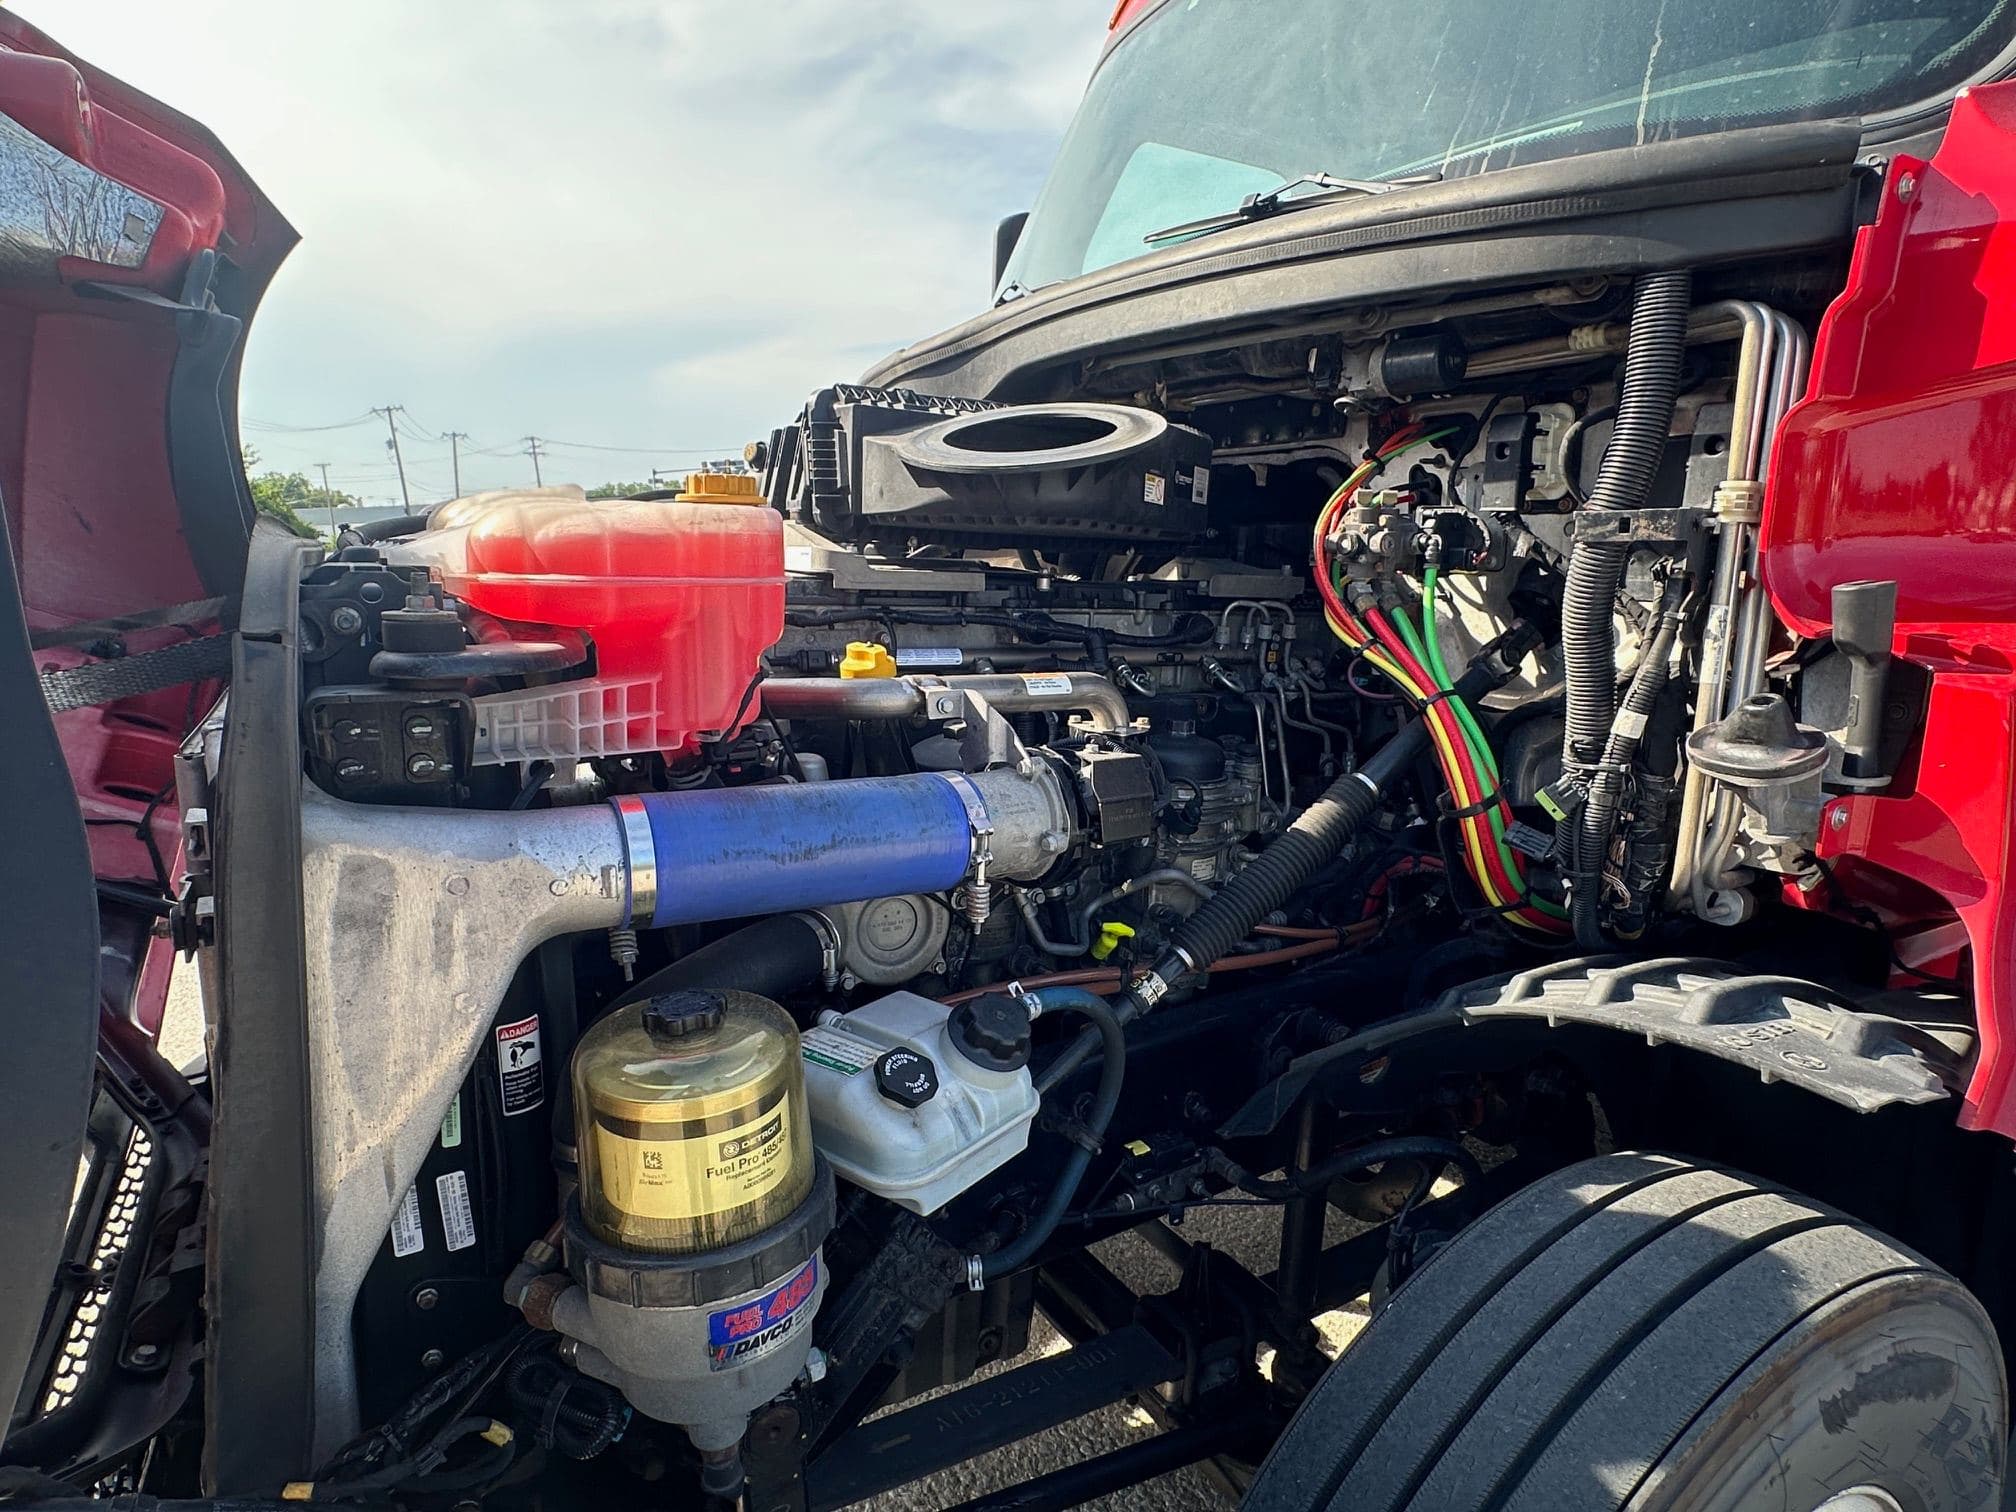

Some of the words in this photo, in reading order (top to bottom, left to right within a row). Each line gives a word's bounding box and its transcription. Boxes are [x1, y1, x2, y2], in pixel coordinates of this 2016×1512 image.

[741, 1119, 779, 1150] DETROIT
[706, 1161, 735, 1179] Fuel
[738, 1154, 760, 1170] Pro
[724, 1304, 764, 1329] FUEL
[728, 1317, 763, 1339] PRO
[733, 1315, 794, 1356] DAVCO
